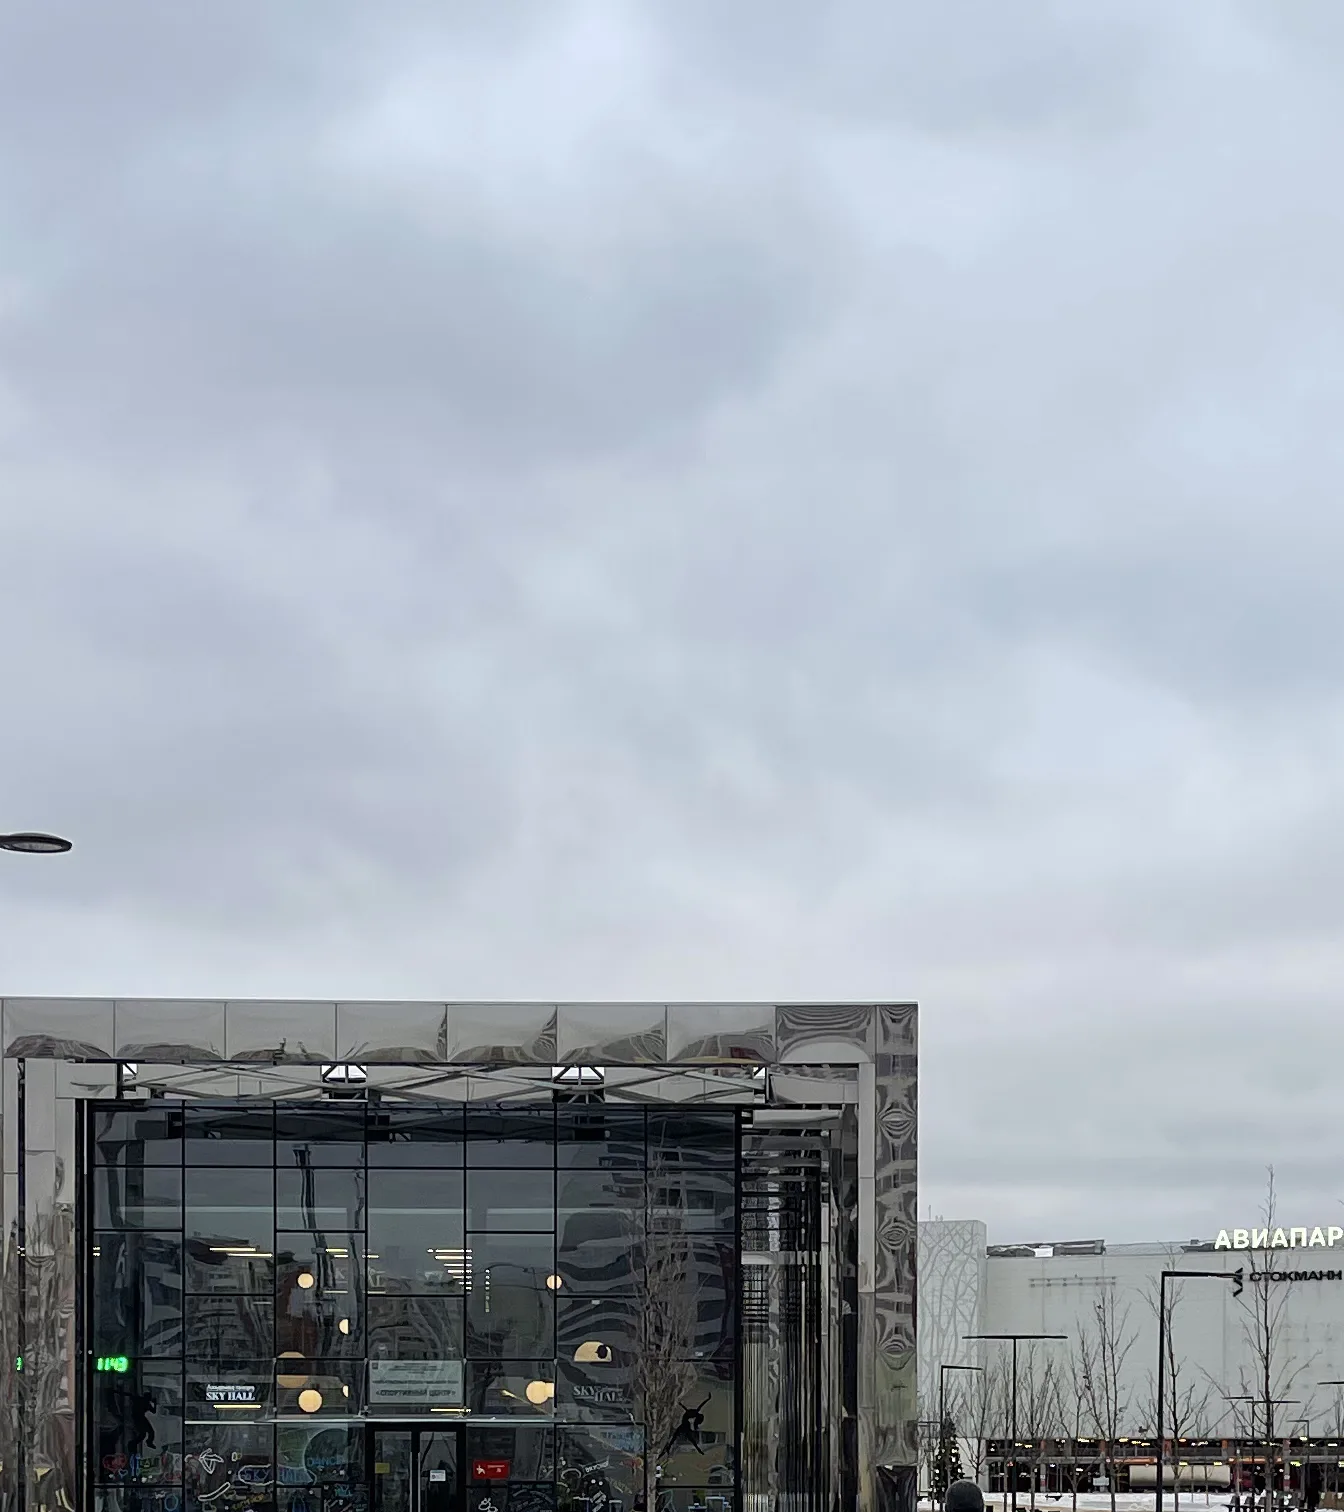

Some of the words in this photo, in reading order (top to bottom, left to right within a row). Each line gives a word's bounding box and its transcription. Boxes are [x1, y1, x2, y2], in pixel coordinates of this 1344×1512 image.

[1249, 1270, 1343, 1281] СТОКМАНН
[206, 1391, 226, 1401] SKY
[227, 1391, 256, 1401] HALL
